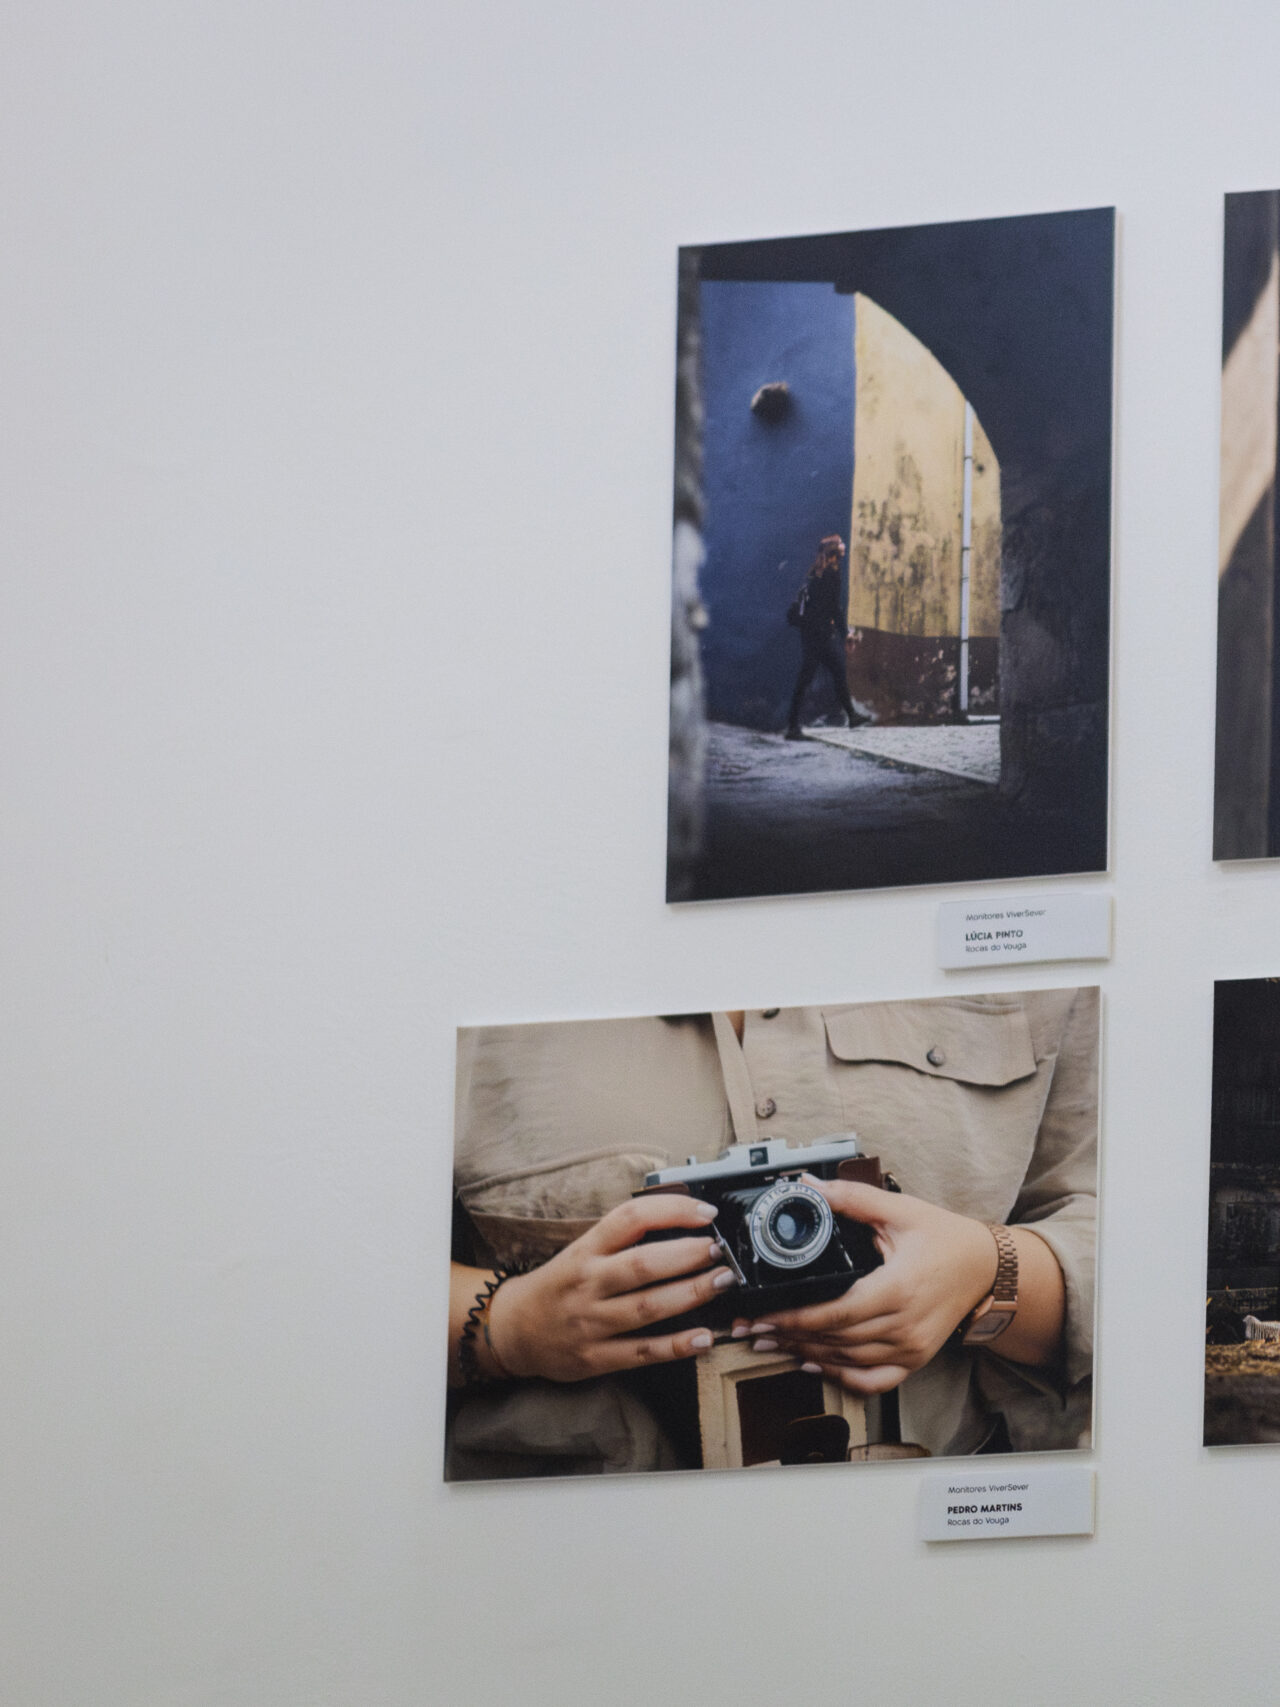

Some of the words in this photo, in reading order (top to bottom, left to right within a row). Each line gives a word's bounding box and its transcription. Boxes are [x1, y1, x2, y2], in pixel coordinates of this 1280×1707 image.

[966, 912, 1004, 921] Monitores
[965, 931, 992, 941] LÚCIA
[996, 929, 1023, 939] PINTO
[991, 943, 1001, 951] do
[1003, 942, 1027, 951] Vouga
[948, 1485, 986, 1494] Monitores
[989, 1483, 1029, 1491] ViverSever
[947, 1505, 978, 1514] PEDRO
[981, 1503, 1022, 1512] MARTINS
[947, 1518, 971, 1526] Rocas
[973, 1517, 983, 1525] do
[986, 1516, 1009, 1525] Vouga
